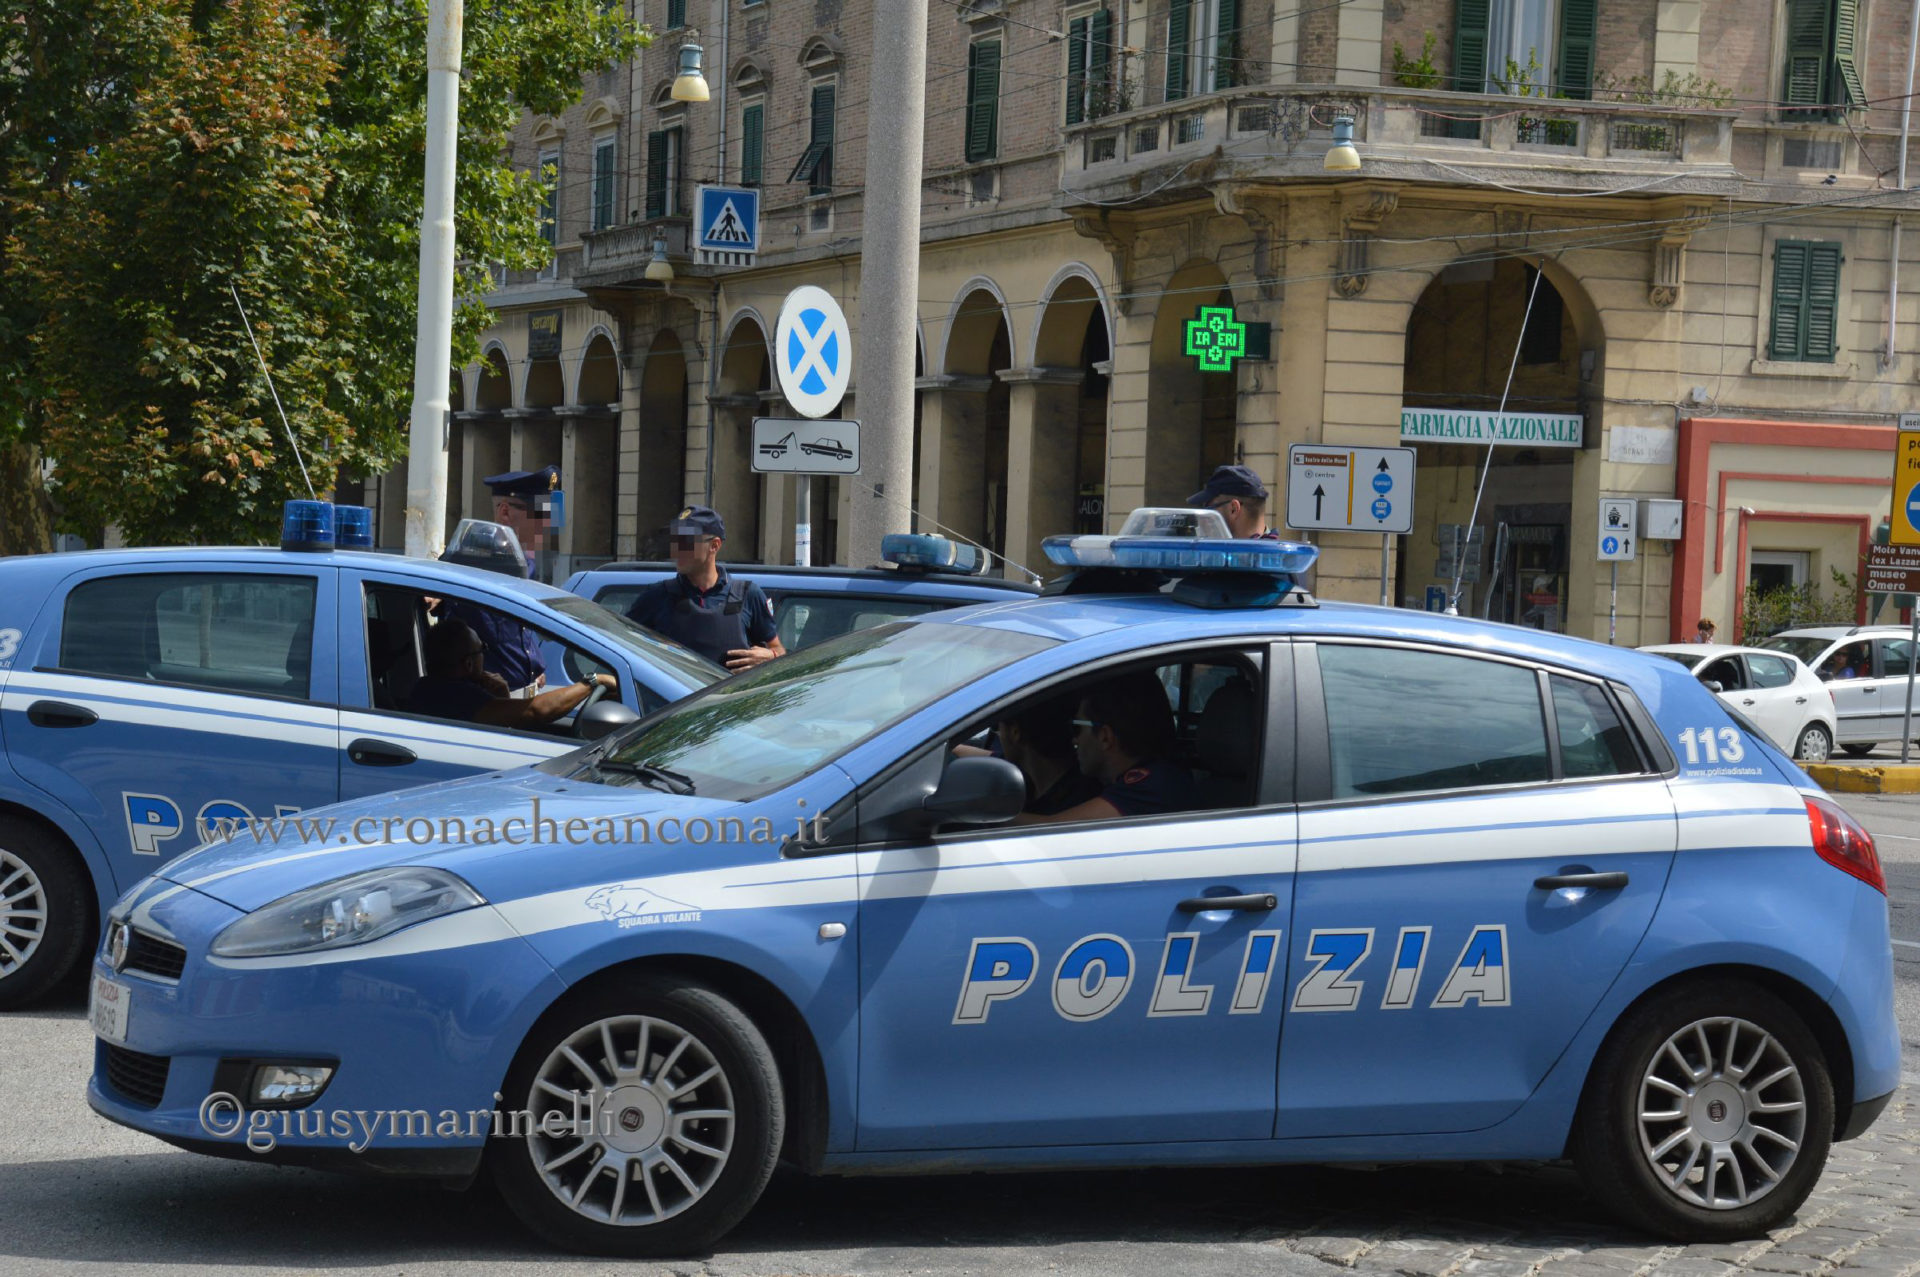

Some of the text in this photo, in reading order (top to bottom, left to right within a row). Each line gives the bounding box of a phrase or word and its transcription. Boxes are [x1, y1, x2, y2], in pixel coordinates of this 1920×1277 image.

[1400, 413, 1579, 442] FARMACIA NAZIONALE
[1873, 545, 1896, 554] Mole
[1869, 570, 1907, 579] museo
[1867, 579, 1906, 590] Omero
[1678, 726, 1745, 764] 113
[618, 911, 702, 929] SQUADRA VOLANTE
[952, 924, 1512, 1026] POLIZIA
